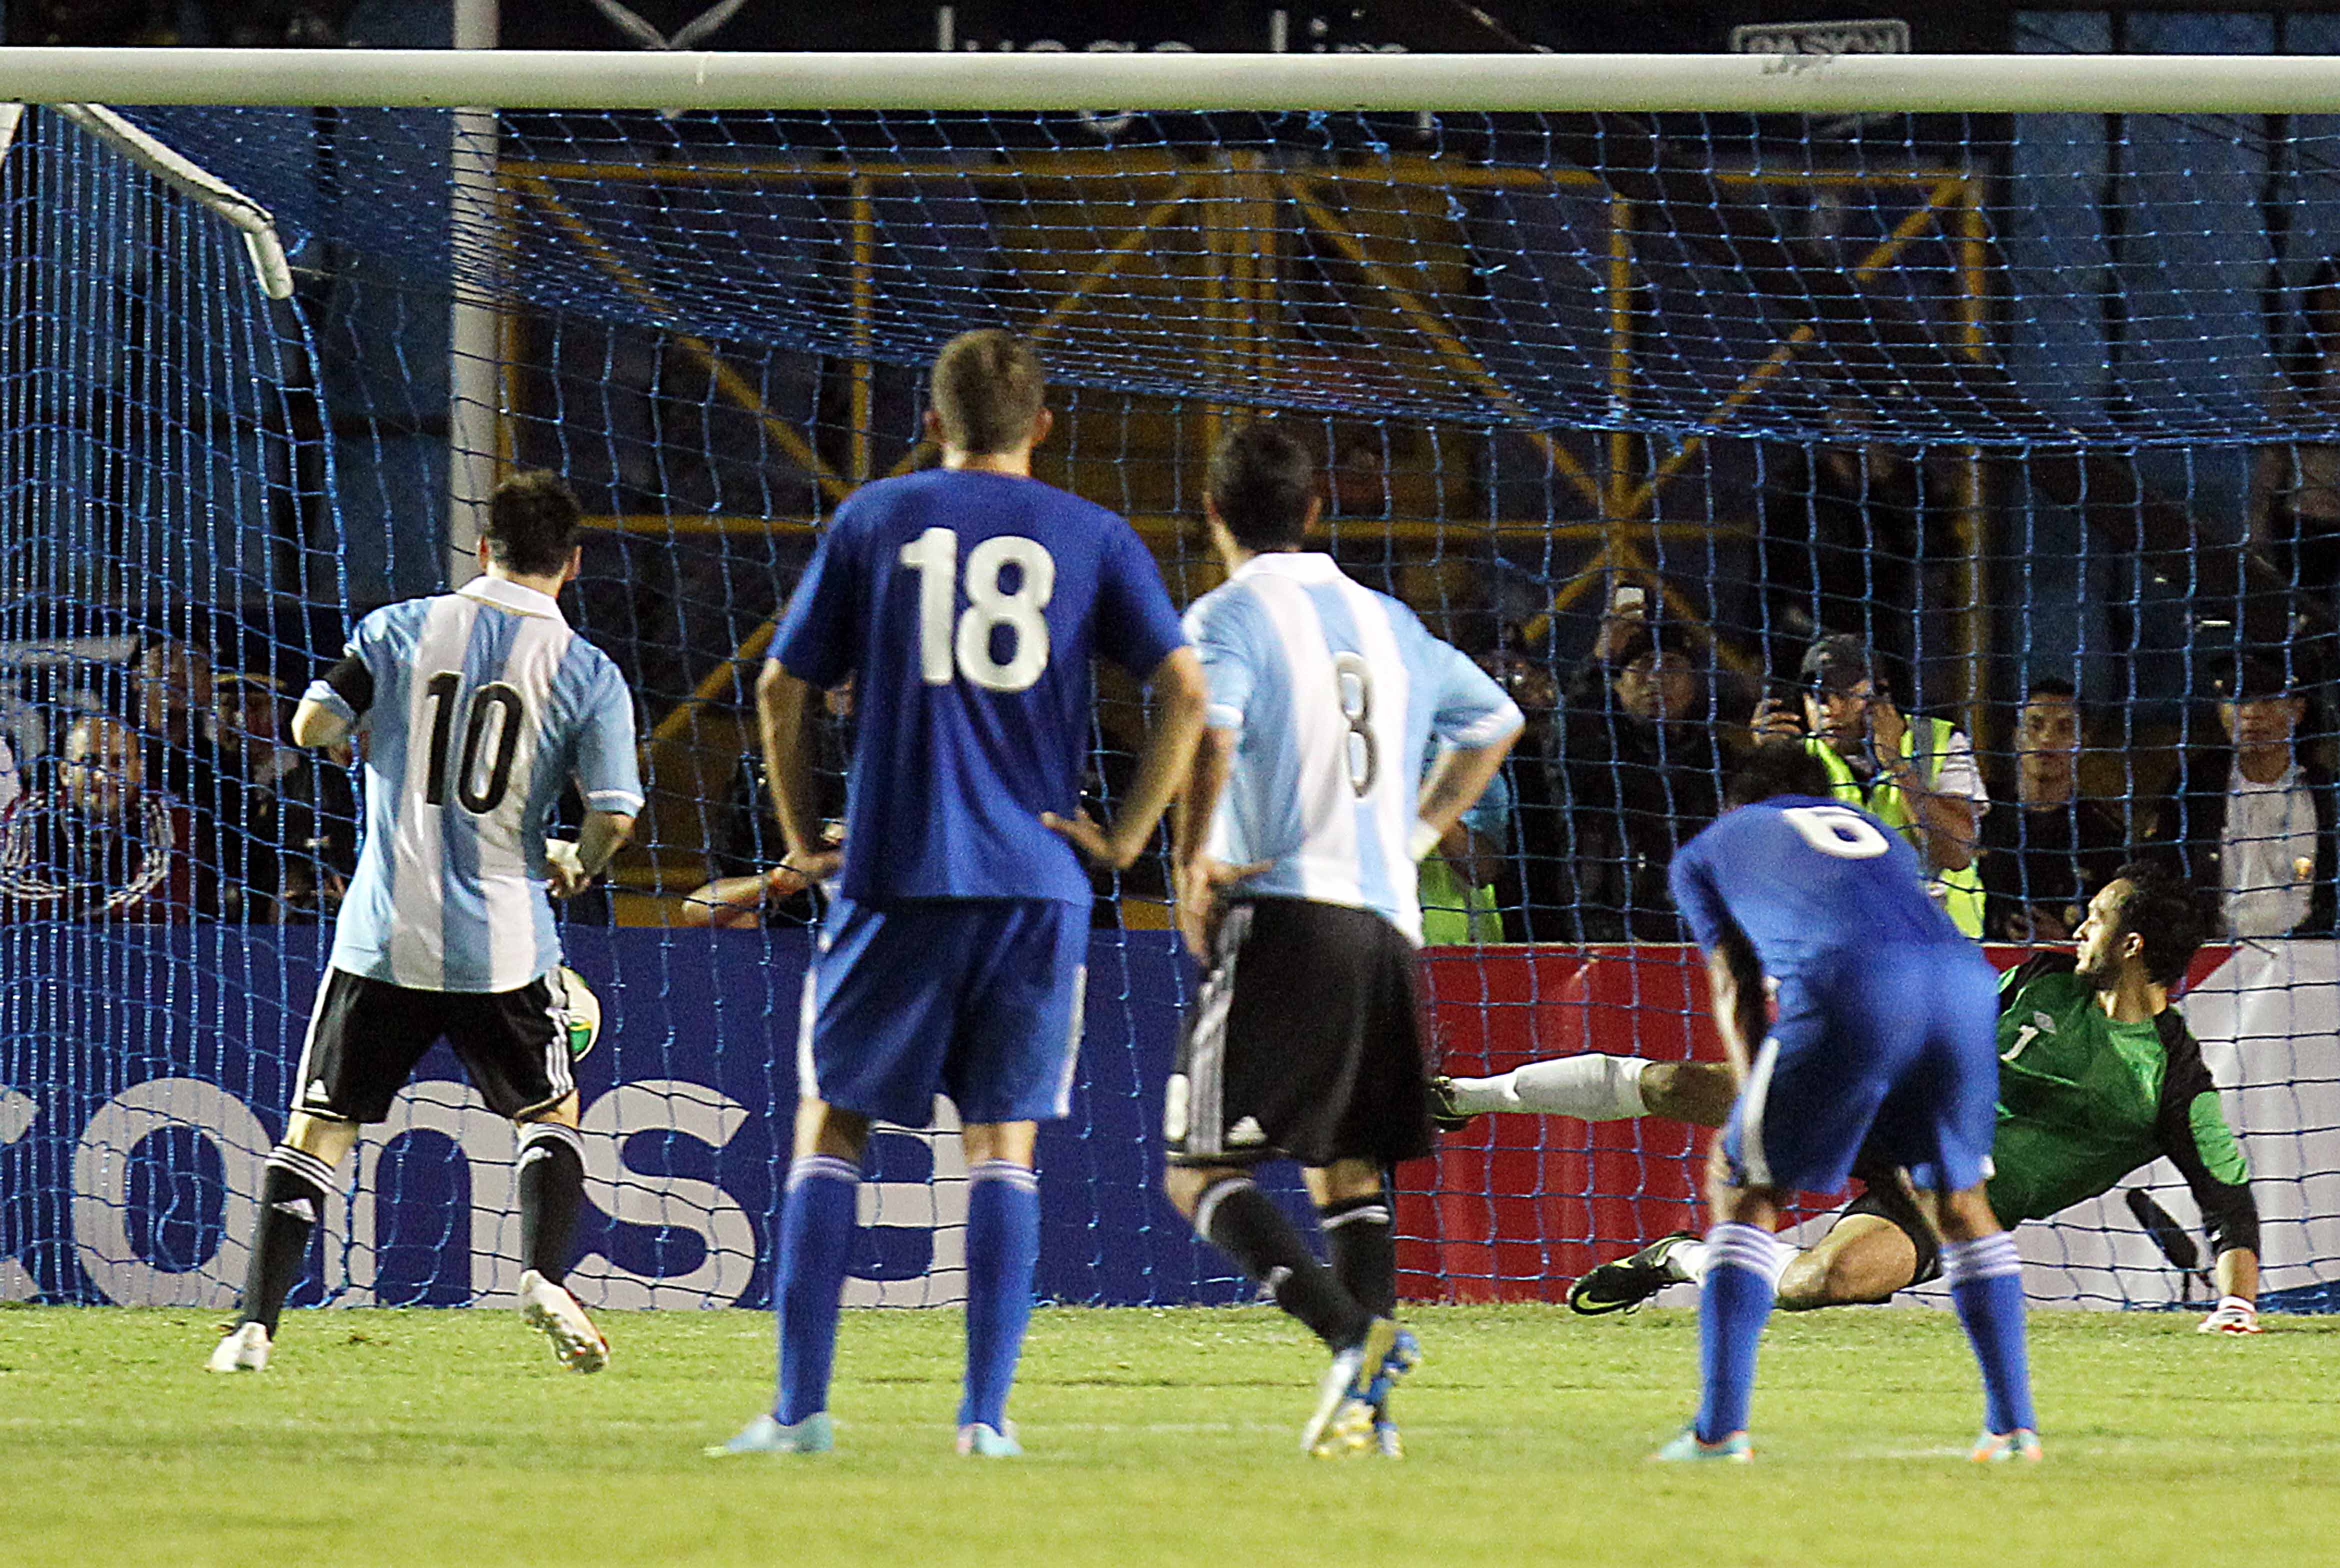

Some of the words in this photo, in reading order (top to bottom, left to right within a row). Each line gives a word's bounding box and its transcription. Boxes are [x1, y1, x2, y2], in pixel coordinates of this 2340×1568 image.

[900, 526, 1056, 692] 18
[426, 671, 523, 815] 10
[1334, 651, 1381, 801] 8
[1782, 806, 1890, 860] 6
